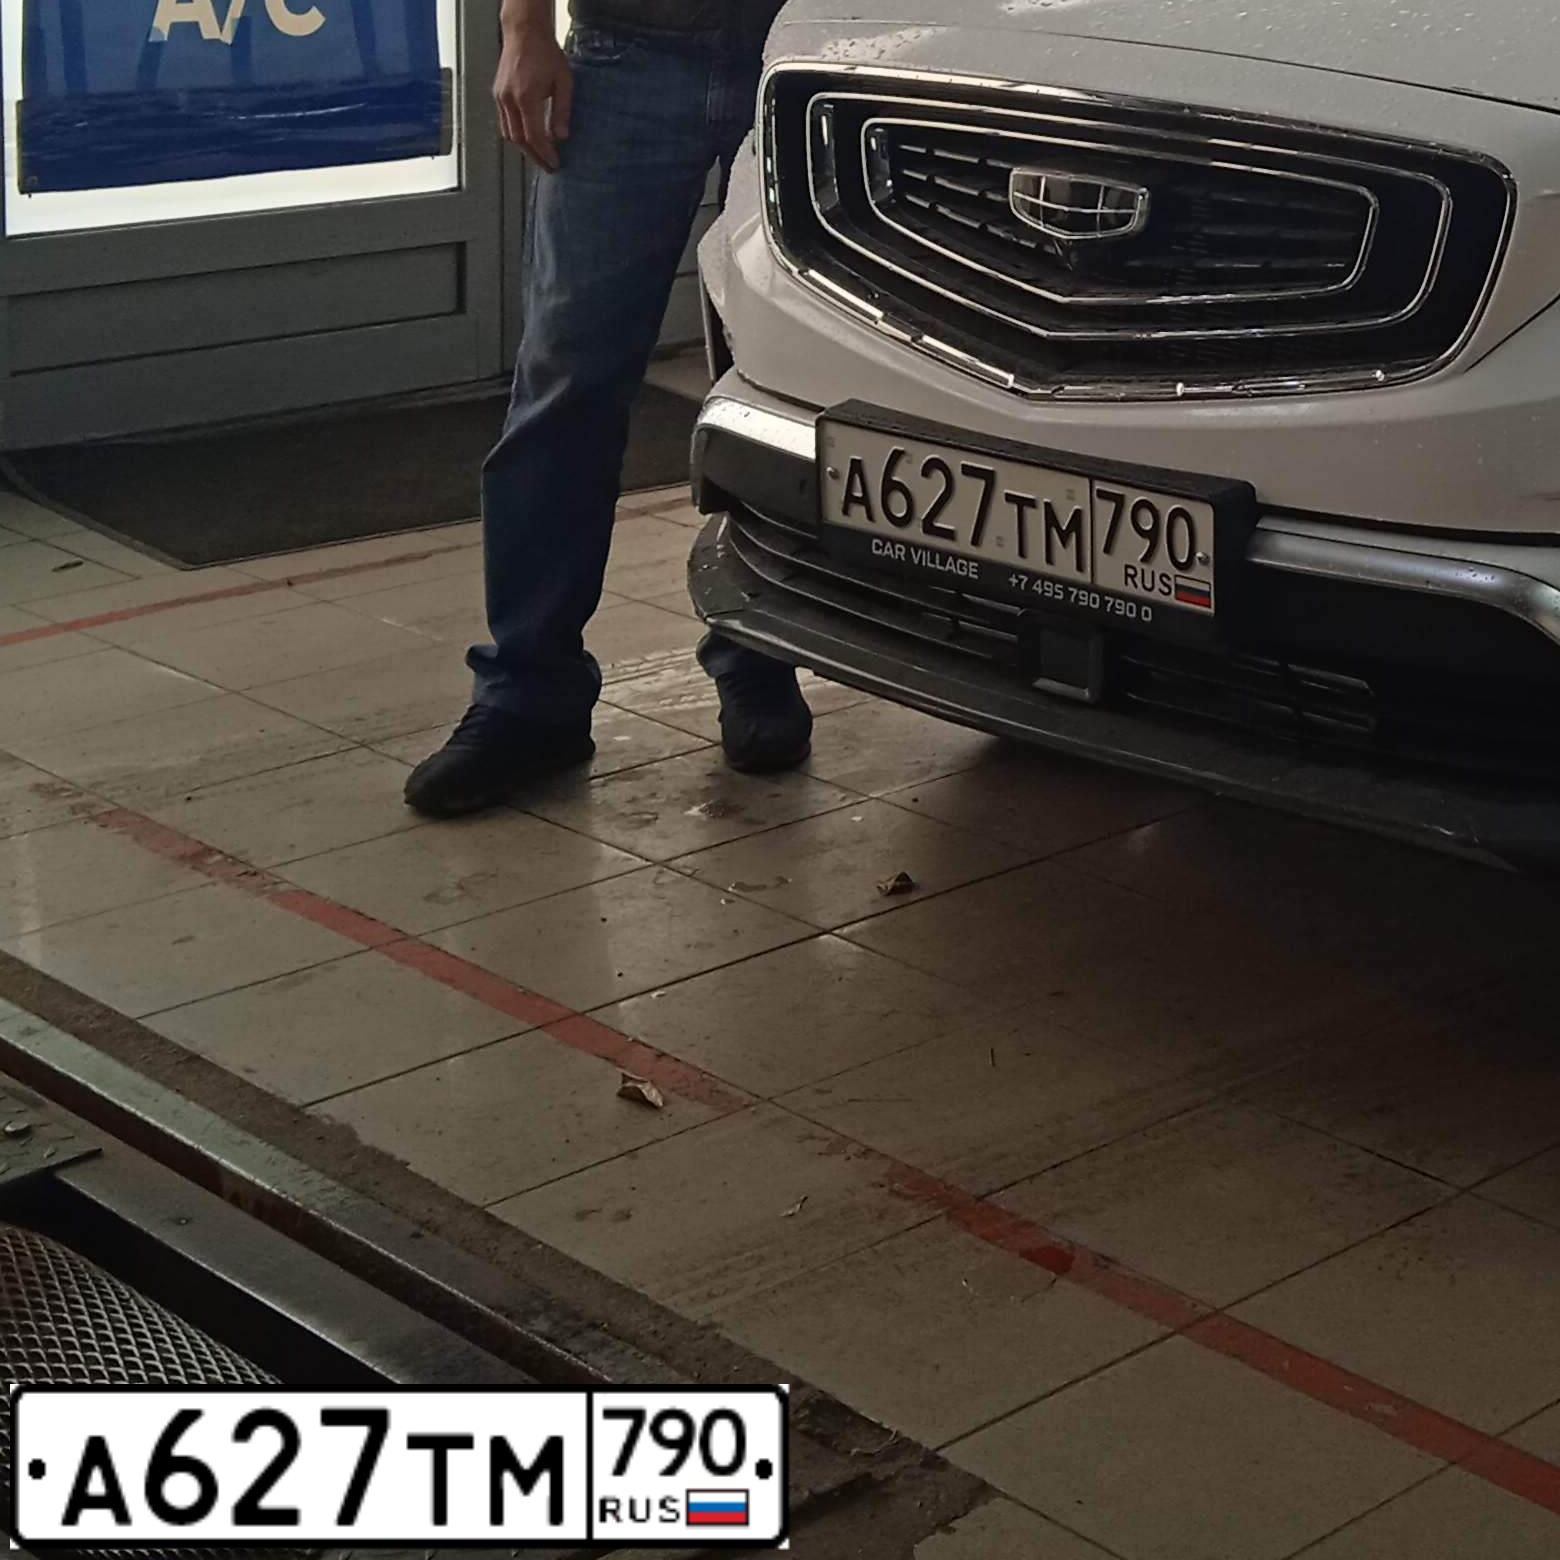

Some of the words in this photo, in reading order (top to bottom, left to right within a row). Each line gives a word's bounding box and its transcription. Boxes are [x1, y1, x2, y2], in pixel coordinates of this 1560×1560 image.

[1096, 488, 1198, 571] 790
[871, 539, 906, 561] CAR
[910, 547, 980, 580] VILLAGE
[1123, 564, 1172, 597] RUS
[1008, 573, 1028, 591] +7
[1032, 579, 1064, 601] 495
[1068, 586, 1100, 609] 790
[1104, 595, 1137, 619] 790
